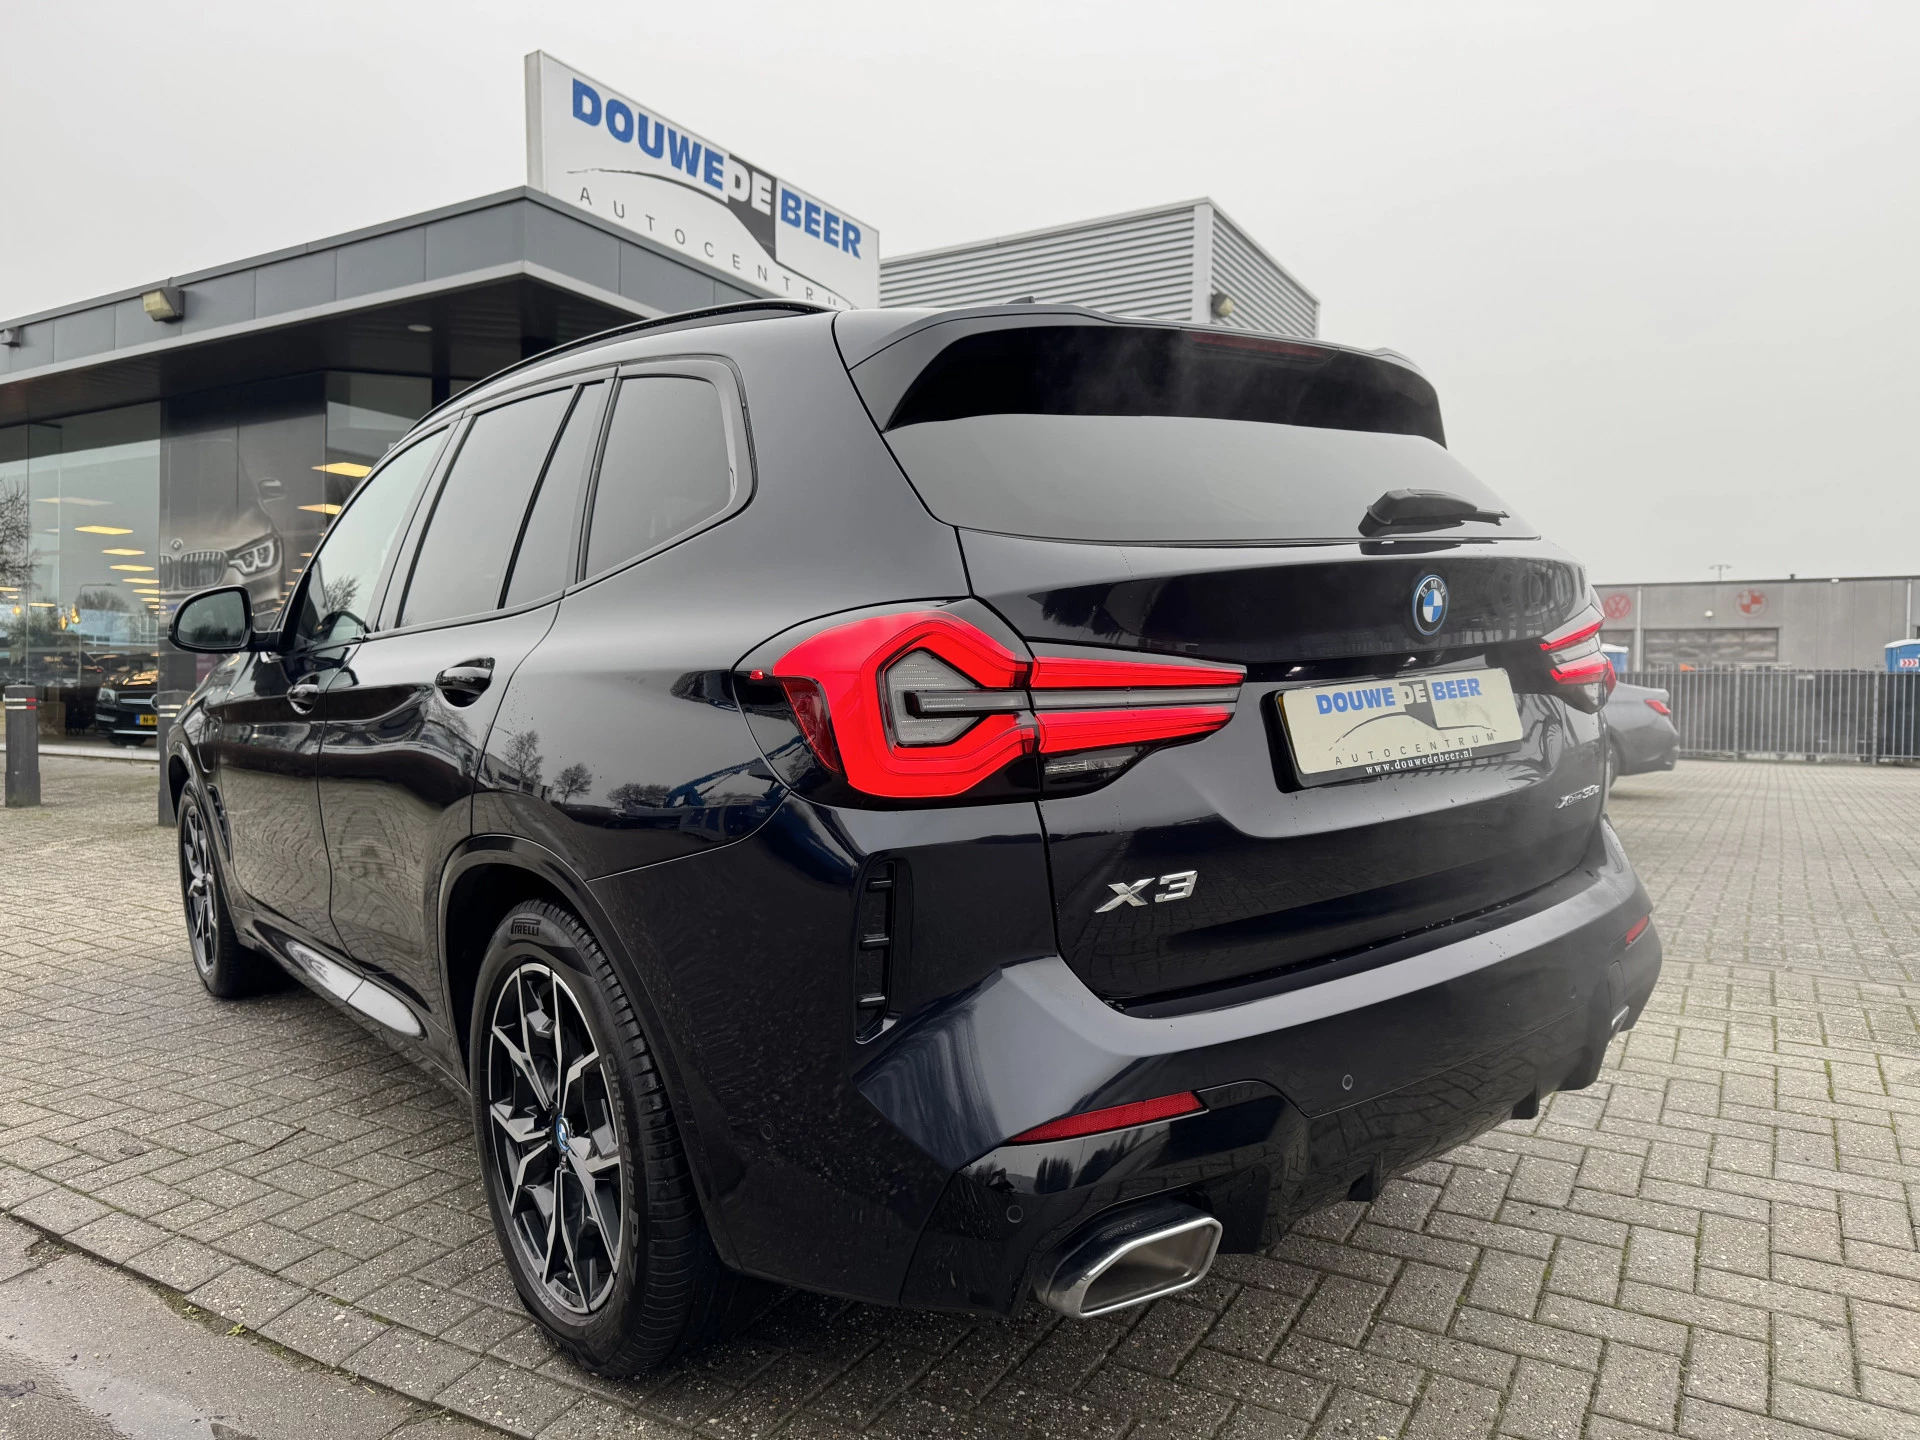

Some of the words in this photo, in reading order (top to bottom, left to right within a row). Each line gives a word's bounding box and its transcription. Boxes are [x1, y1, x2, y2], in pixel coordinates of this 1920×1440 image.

[572, 77, 724, 191] DOUWE
[725, 157, 772, 216] DE
[780, 187, 862, 260] BEER
[579, 186, 856, 310] AUTOCENTRU
[1315, 686, 1396, 715] DOUWE
[1399, 682, 1428, 704] DE
[1430, 677, 1483, 701] BEER
[1335, 732, 1495, 766] AUTOCENTRUM
[1365, 746, 1474, 775] www.douwedebeer.nl
[1094, 870, 1198, 913] X3
[511, 917, 541, 937] PIRELLI
